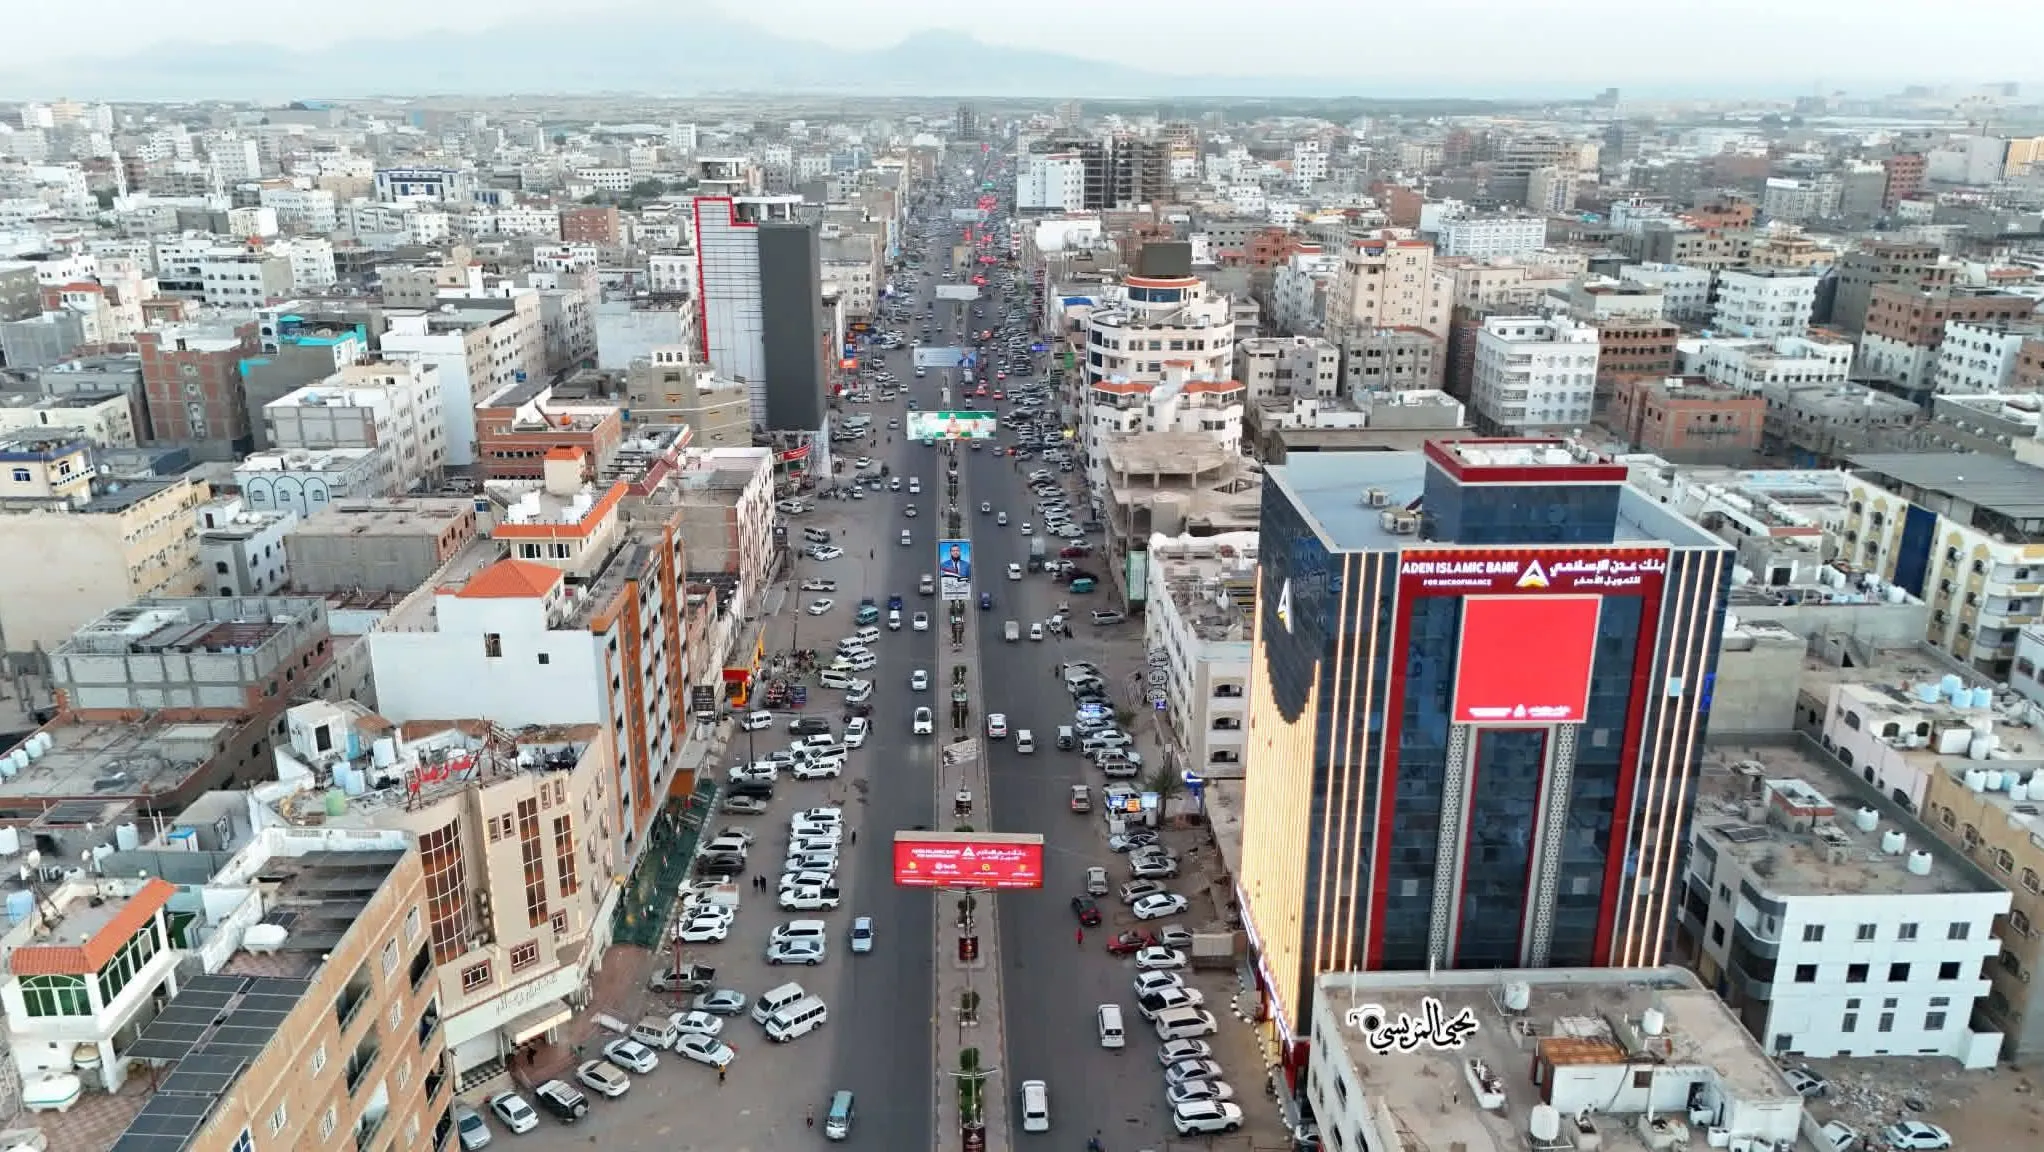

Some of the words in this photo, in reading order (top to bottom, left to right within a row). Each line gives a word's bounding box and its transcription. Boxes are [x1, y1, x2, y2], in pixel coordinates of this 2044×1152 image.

[1401, 562, 1434, 574] ADEN
[1435, 562, 1484, 573] ISLAMIC
[1485, 561, 1519, 573] BANK
[1549, 559, 1610, 577] الإسلامي
[1610, 560, 1637, 574] عدن
[1638, 559, 1665, 574] بنك
